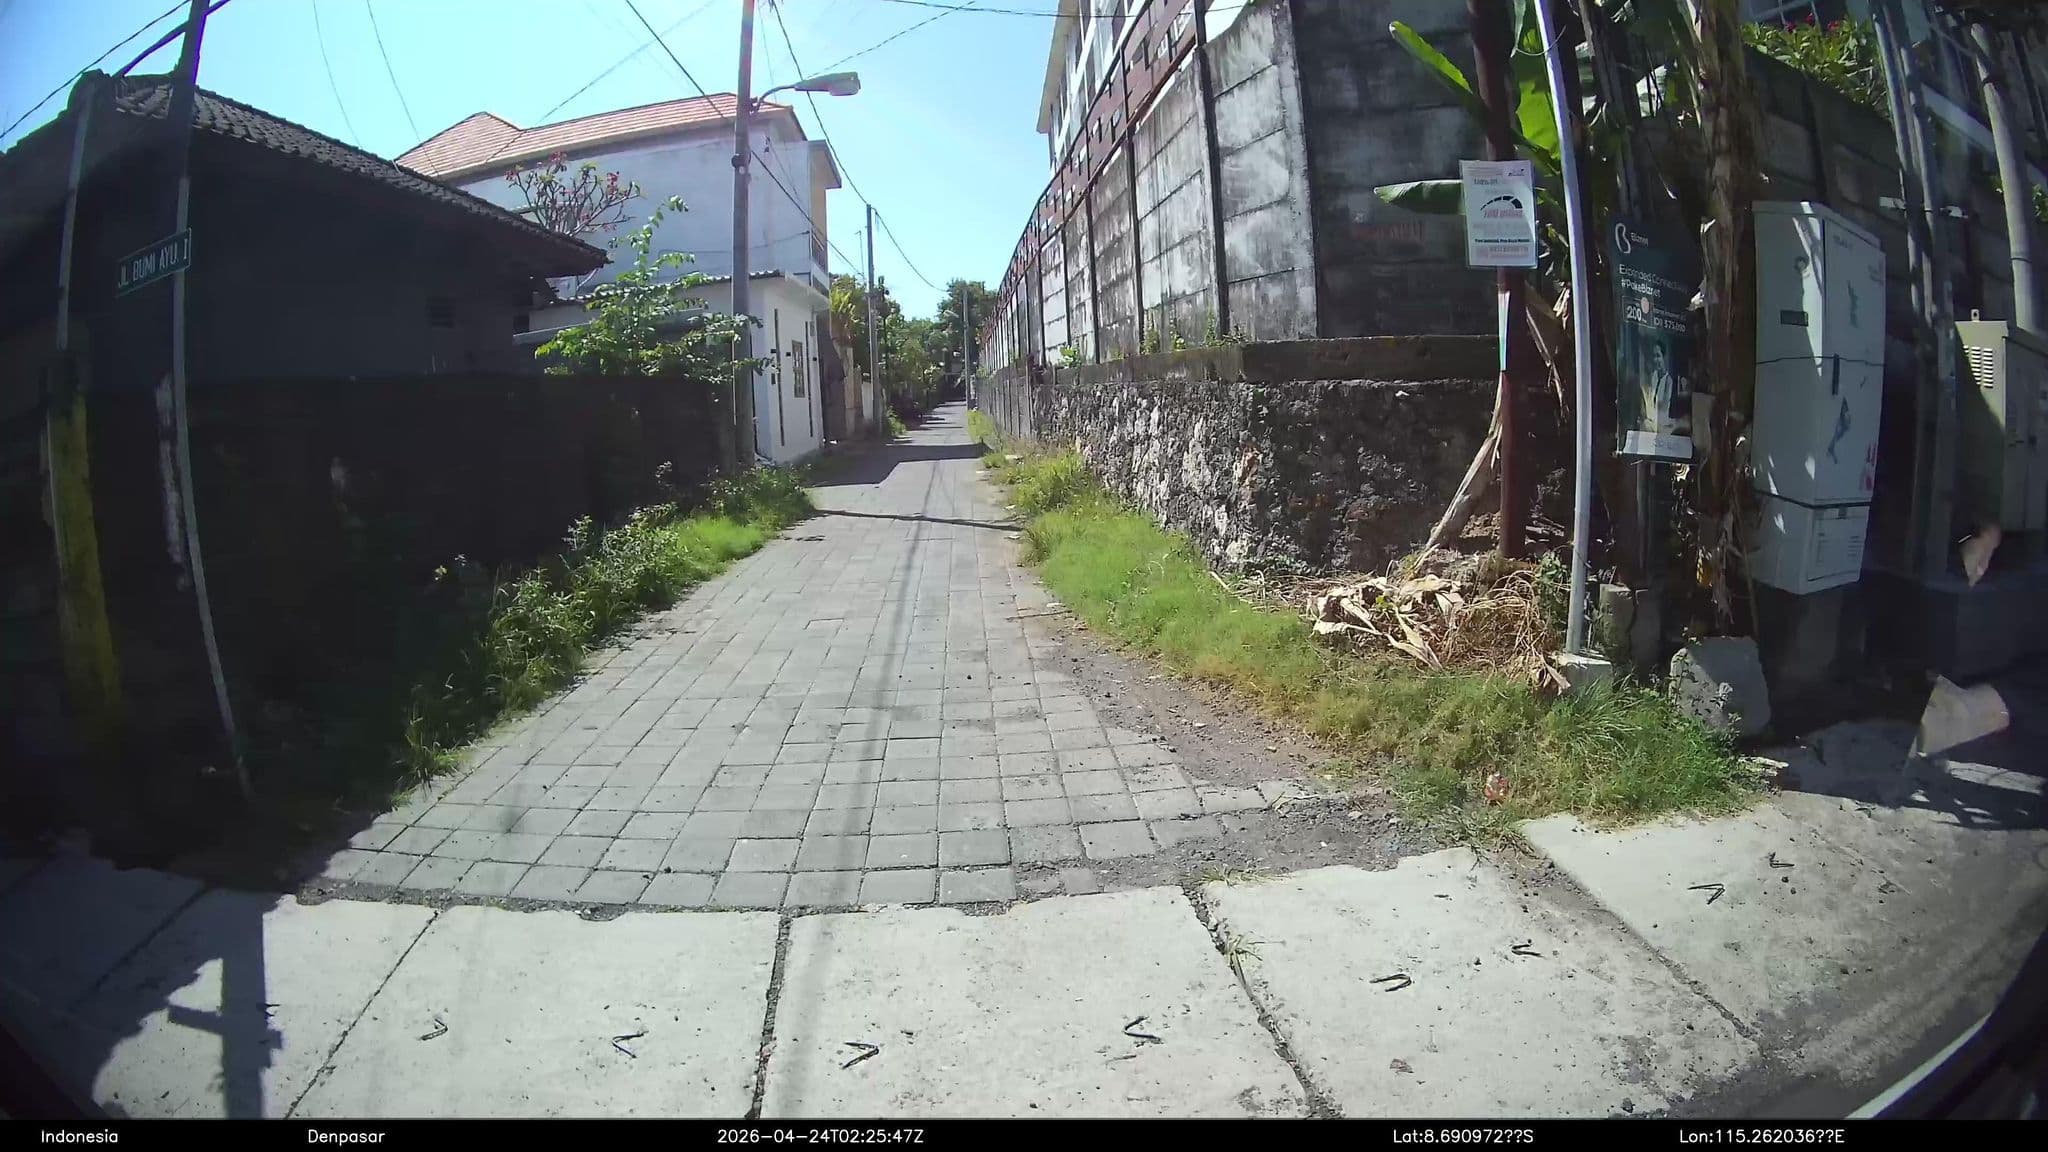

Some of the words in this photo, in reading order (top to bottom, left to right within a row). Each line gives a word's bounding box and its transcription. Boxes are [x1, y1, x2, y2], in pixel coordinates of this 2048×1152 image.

[133, 252, 155, 282] BUMI
[183, 238, 188, 260] I
[1626, 305, 1642, 322] 200
